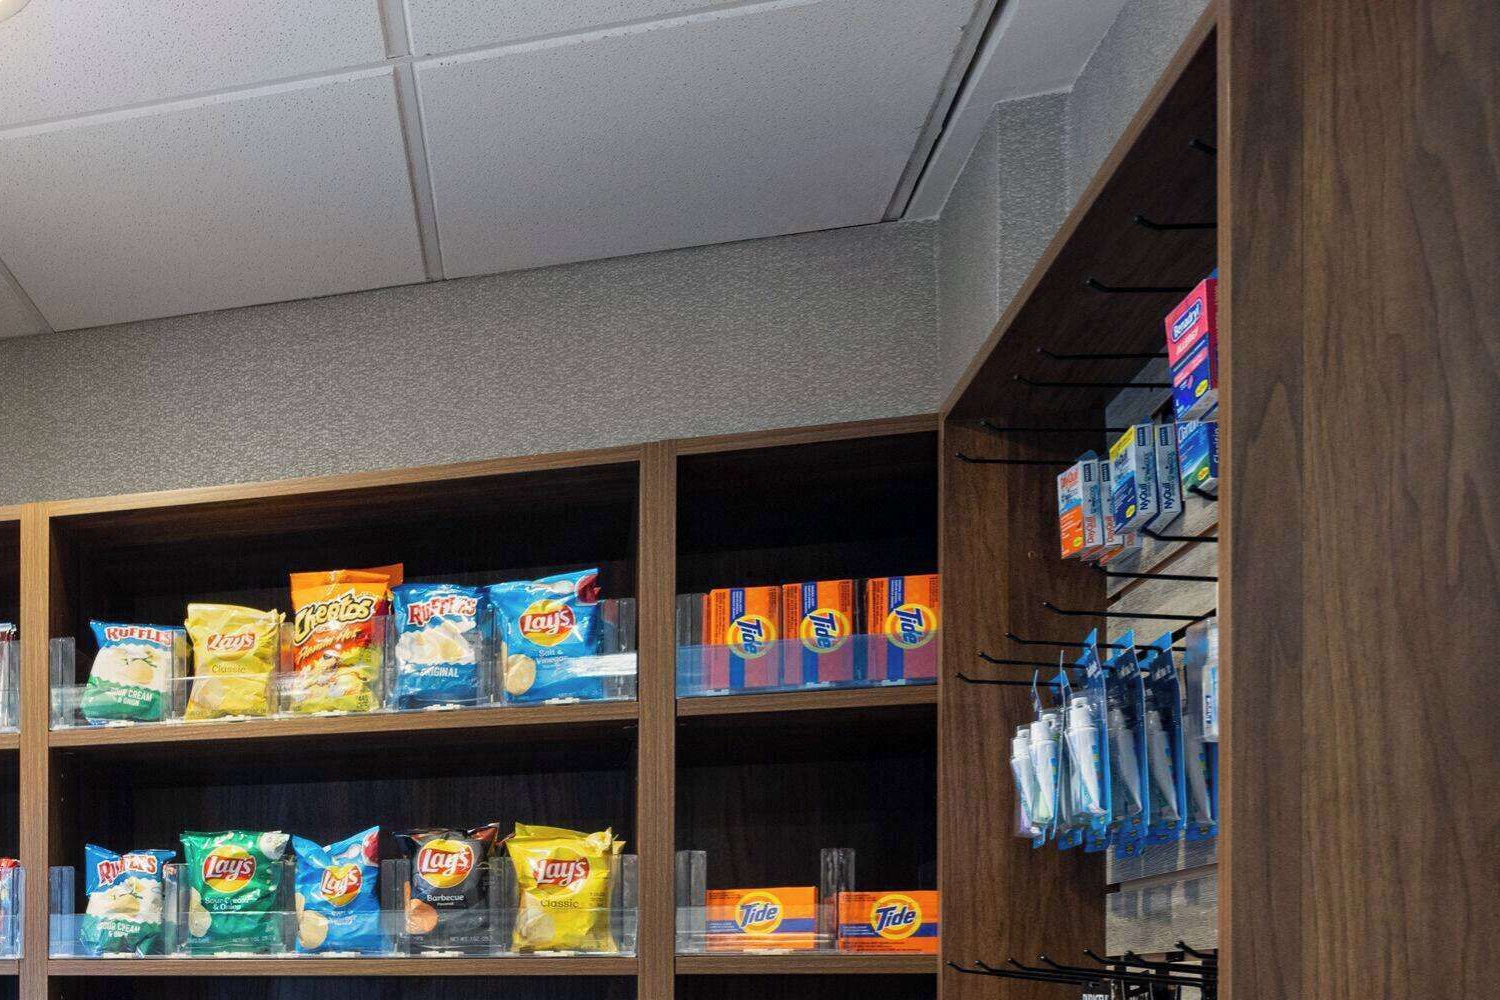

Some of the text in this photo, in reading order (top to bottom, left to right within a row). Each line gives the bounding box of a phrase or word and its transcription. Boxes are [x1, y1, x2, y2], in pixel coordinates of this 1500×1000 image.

[294, 593, 375, 645] Cheetos
[523, 608, 575, 635] Lay's
[809, 612, 837, 650] Tide
[896, 607, 925, 645] Tide
[105, 626, 173, 646] RUFFLES
[419, 666, 460, 679] ORIGINAL
[204, 855, 255, 880] Lay's
[419, 847, 473, 877] Lay's
[536, 857, 588, 885] Lay's
[426, 893, 465, 902] Barbecue
[739, 902, 779, 928] Tide
[875, 905, 917, 932] Tide
